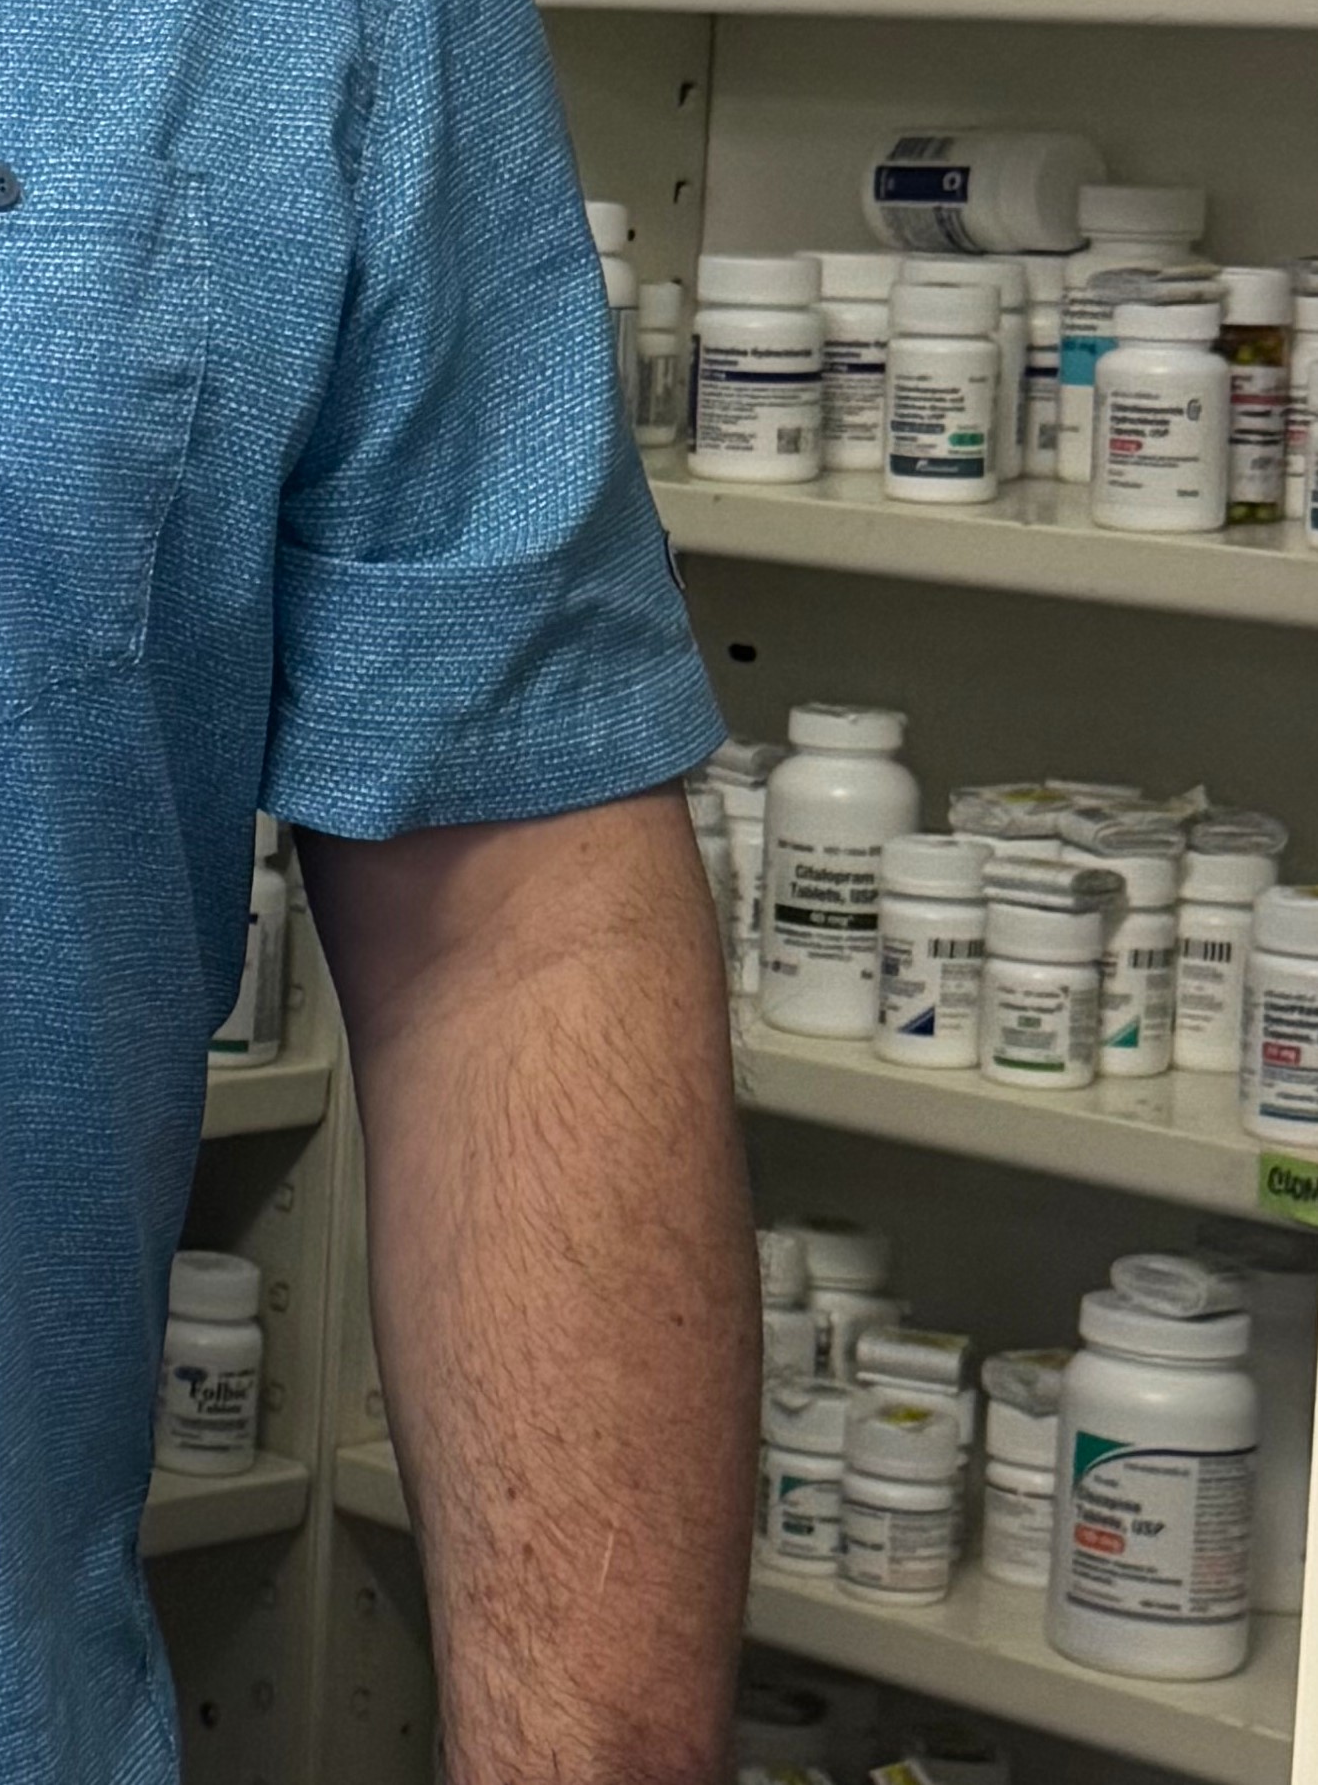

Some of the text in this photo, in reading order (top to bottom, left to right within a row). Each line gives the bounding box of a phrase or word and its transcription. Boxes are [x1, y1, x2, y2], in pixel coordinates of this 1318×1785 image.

[796, 864, 875, 885] Citalopram
[791, 882, 880, 905] Tablets, USP
